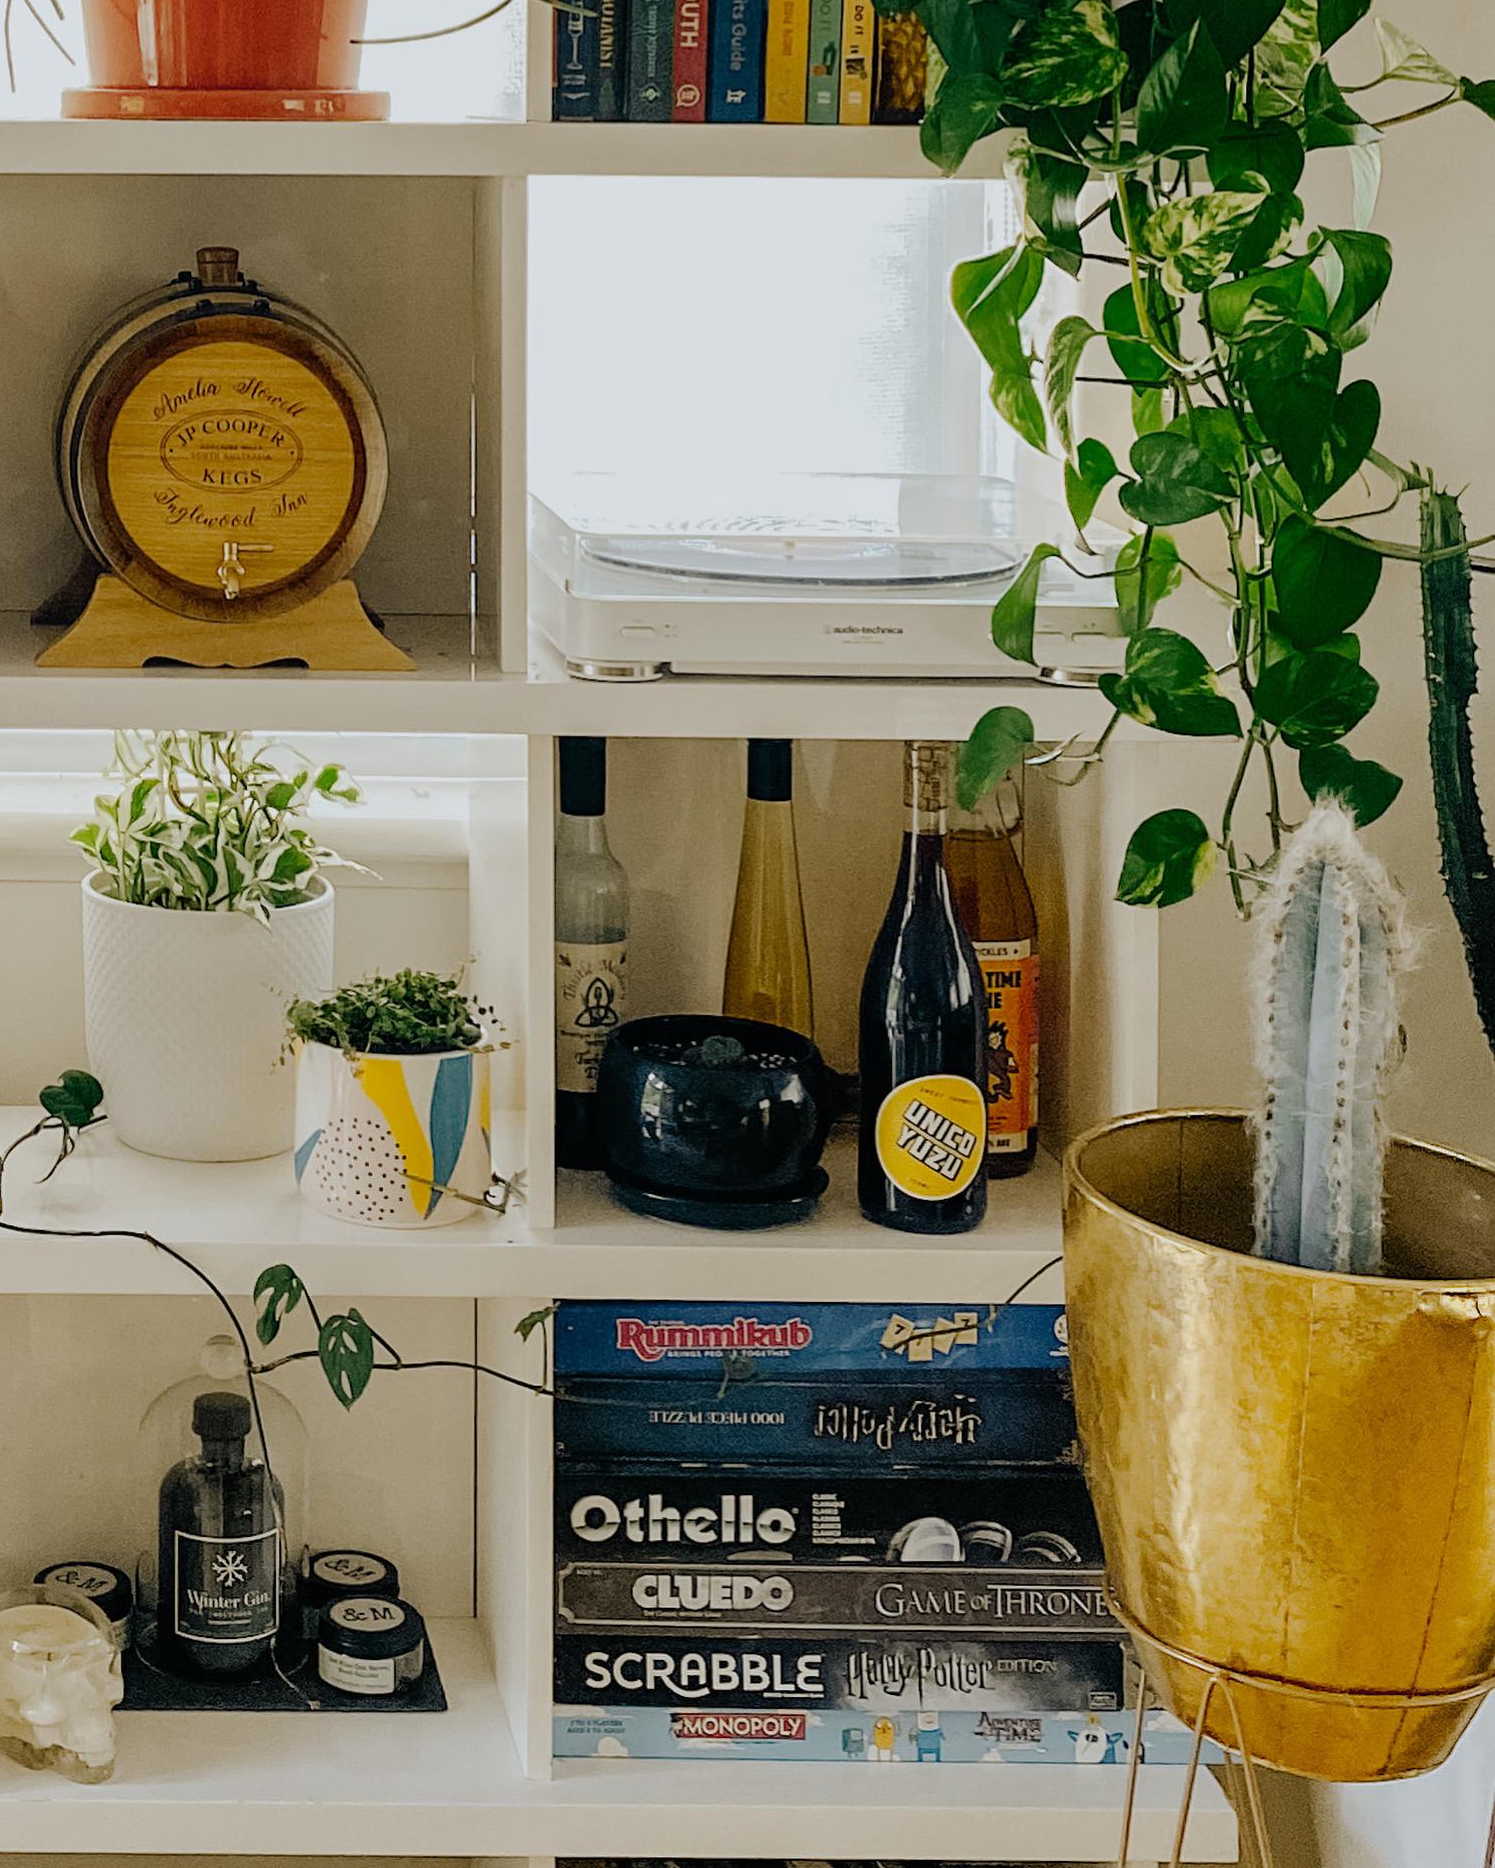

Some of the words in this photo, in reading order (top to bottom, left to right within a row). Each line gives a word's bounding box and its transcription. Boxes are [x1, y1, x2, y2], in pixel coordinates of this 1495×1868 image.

[820, 18, 831, 32] IT
[854, 4, 863, 21] DO
[854, 25, 863, 36] IT
[729, 23, 746, 71] Guide
[154, 378, 222, 421] Amelia
[234, 376, 307, 418] Howell
[177, 425, 196, 447] JP
[202, 419, 285, 447] COOPER
[202, 468, 263, 485] KEGS
[154, 487, 256, 528] Inglewood
[272, 492, 307, 517] Inn
[832, 625, 904, 634] audio-technica
[986, 971, 1021, 988] TIME
[903, 1098, 977, 1159] UNICO
[897, 1123, 963, 1182] YUZU
[616, 1316, 813, 1362] Rummikub
[894, 1324, 905, 1335] 7
[649, 1411, 702, 1425] PUZZLE
[708, 1411, 748, 1425] PIECE
[750, 1412, 785, 1425] 1000
[814, 1405, 897, 1450] Potter
[899, 1400, 983, 1445] Harry
[570, 1494, 797, 1544] Othello
[76, 1575, 104, 1592] M
[632, 1574, 794, 1611] CLUEDO
[187, 1588, 241, 1613] Winter
[875, 1583, 966, 1618] GAME
[987, 1584, 1118, 1619] THRONE
[343, 1608, 365, 1622] &
[368, 1607, 395, 1622] M
[585, 1652, 825, 1699] SCRABBLE
[847, 1650, 911, 1700] Harry
[917, 1647, 996, 1709] Potter
[997, 1659, 1057, 1673] EDITION
[684, 1716, 802, 1737] MONOPOLY
